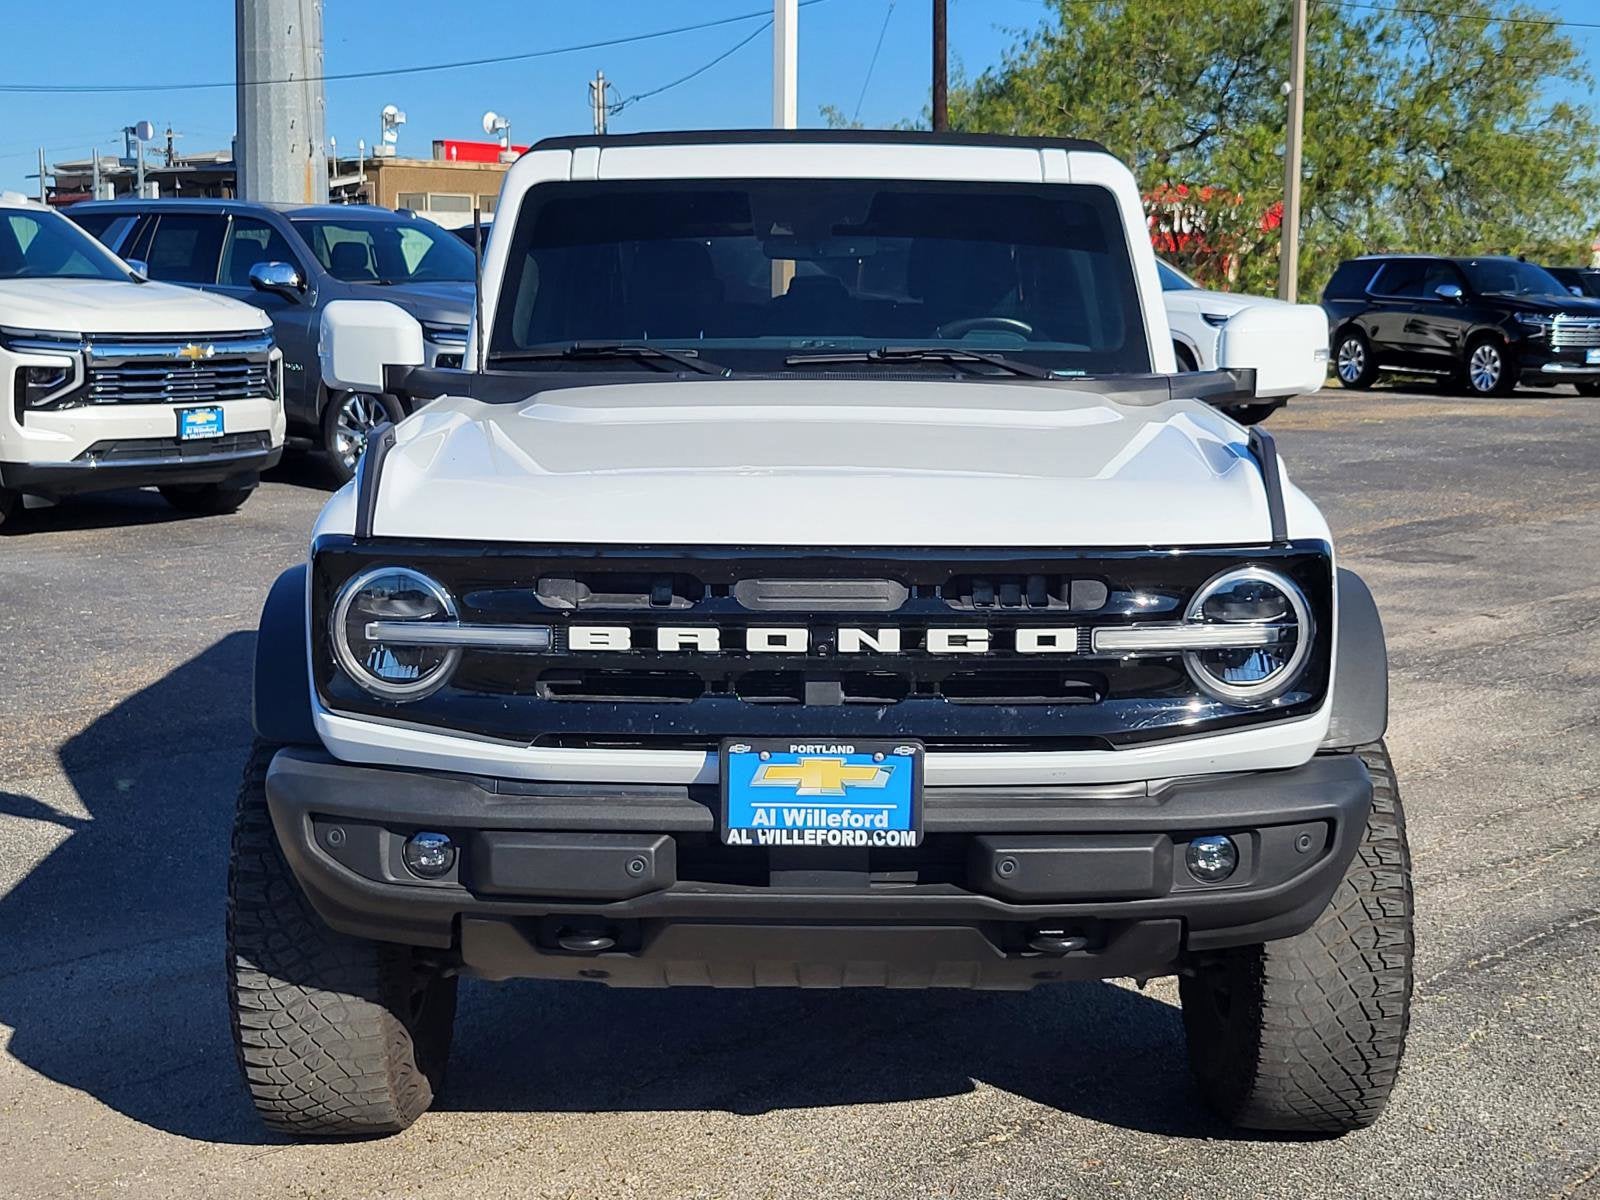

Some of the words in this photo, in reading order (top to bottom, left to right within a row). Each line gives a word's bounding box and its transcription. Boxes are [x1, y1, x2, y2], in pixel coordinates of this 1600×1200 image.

[568, 626, 1078, 653] BRONCO
[790, 744, 855, 754] PORTLAND
[752, 808, 776, 826] Al
[783, 808, 888, 828] Willeford
[727, 828, 752, 845] AL
[757, 829, 916, 846] WILLEFORD.COM
